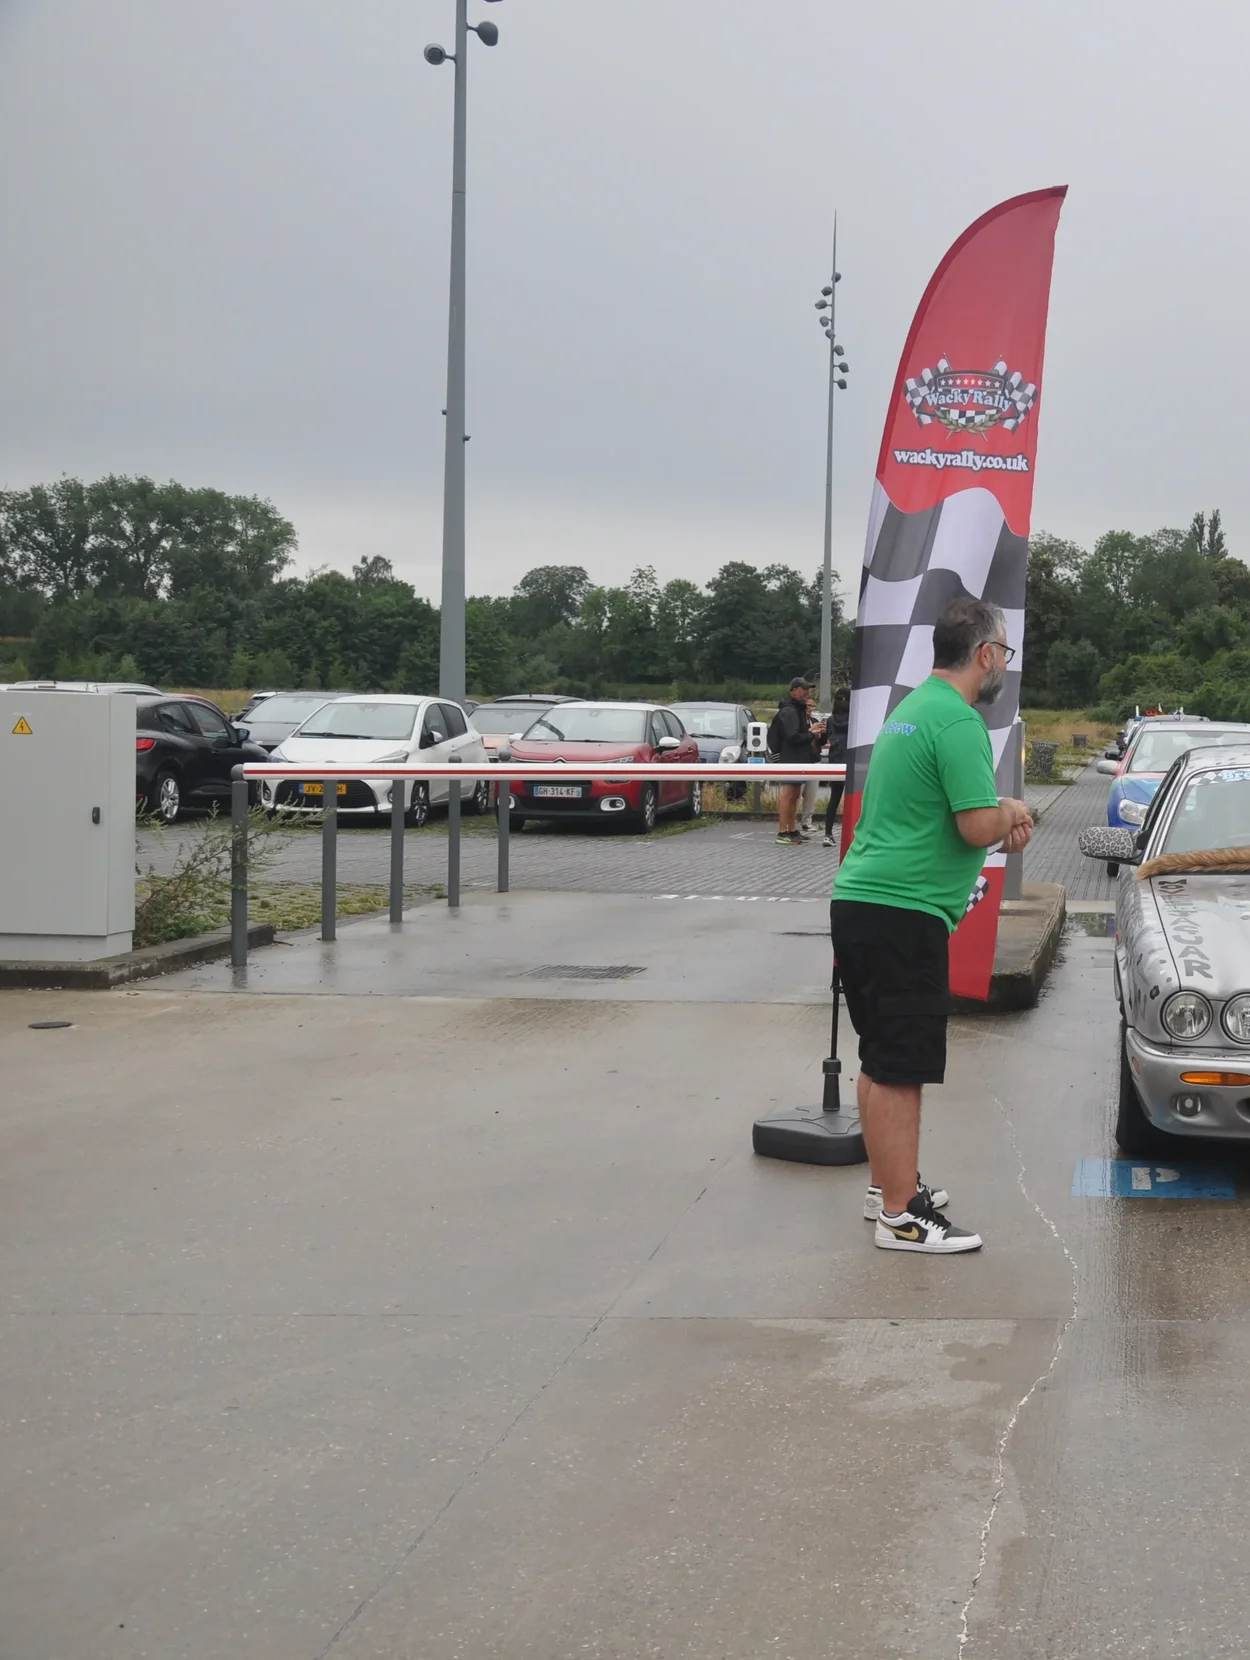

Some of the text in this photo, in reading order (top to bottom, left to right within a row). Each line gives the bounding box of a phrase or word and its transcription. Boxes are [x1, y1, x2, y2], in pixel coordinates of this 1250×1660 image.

[925, 390, 1013, 411] Wacky Rally
[893, 449, 1029, 471] wackyrally.co.uk
